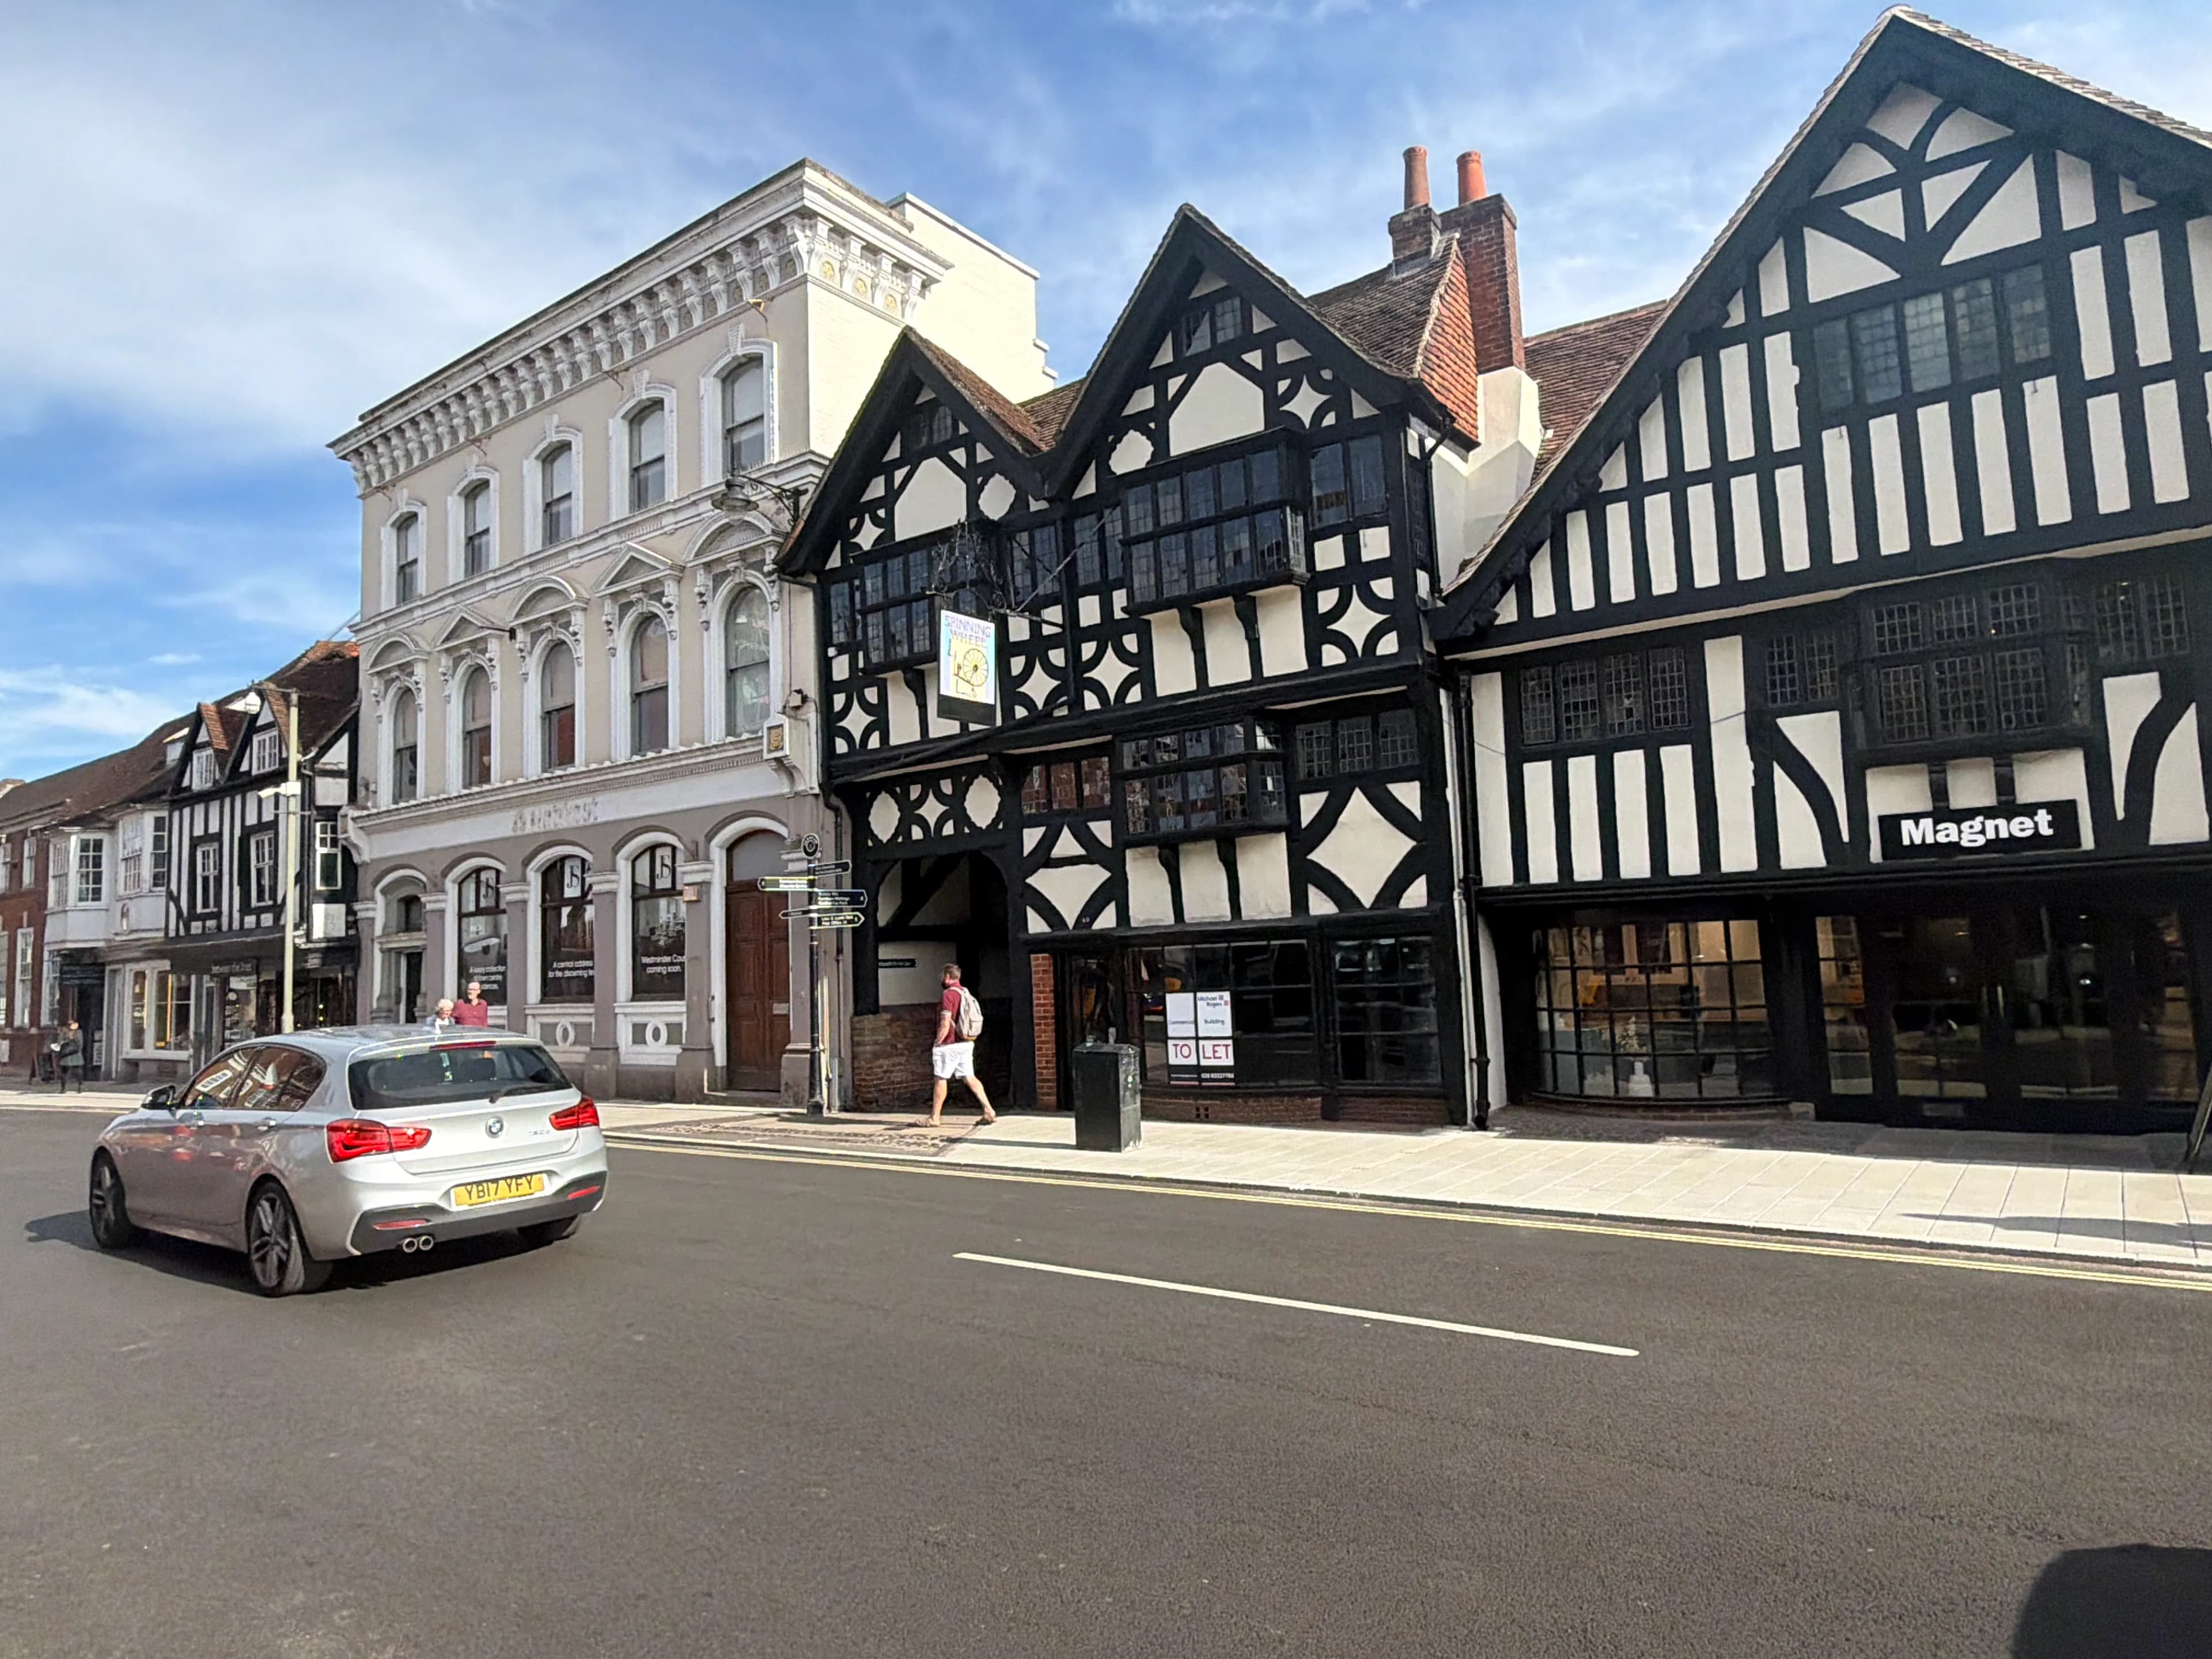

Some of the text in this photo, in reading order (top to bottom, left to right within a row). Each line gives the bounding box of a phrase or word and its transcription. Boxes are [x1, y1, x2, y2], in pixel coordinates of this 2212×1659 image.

[945, 615, 991, 637] SPINNING
[949, 630, 987, 648] WHEEL
[1900, 808, 2054, 847] Magnet
[672, 954, 685, 962] Cou
[646, 966, 667, 975] coming
[1172, 1043, 1231, 1060] TO LET
[465, 1175, 533, 1200] YB17 YFY
